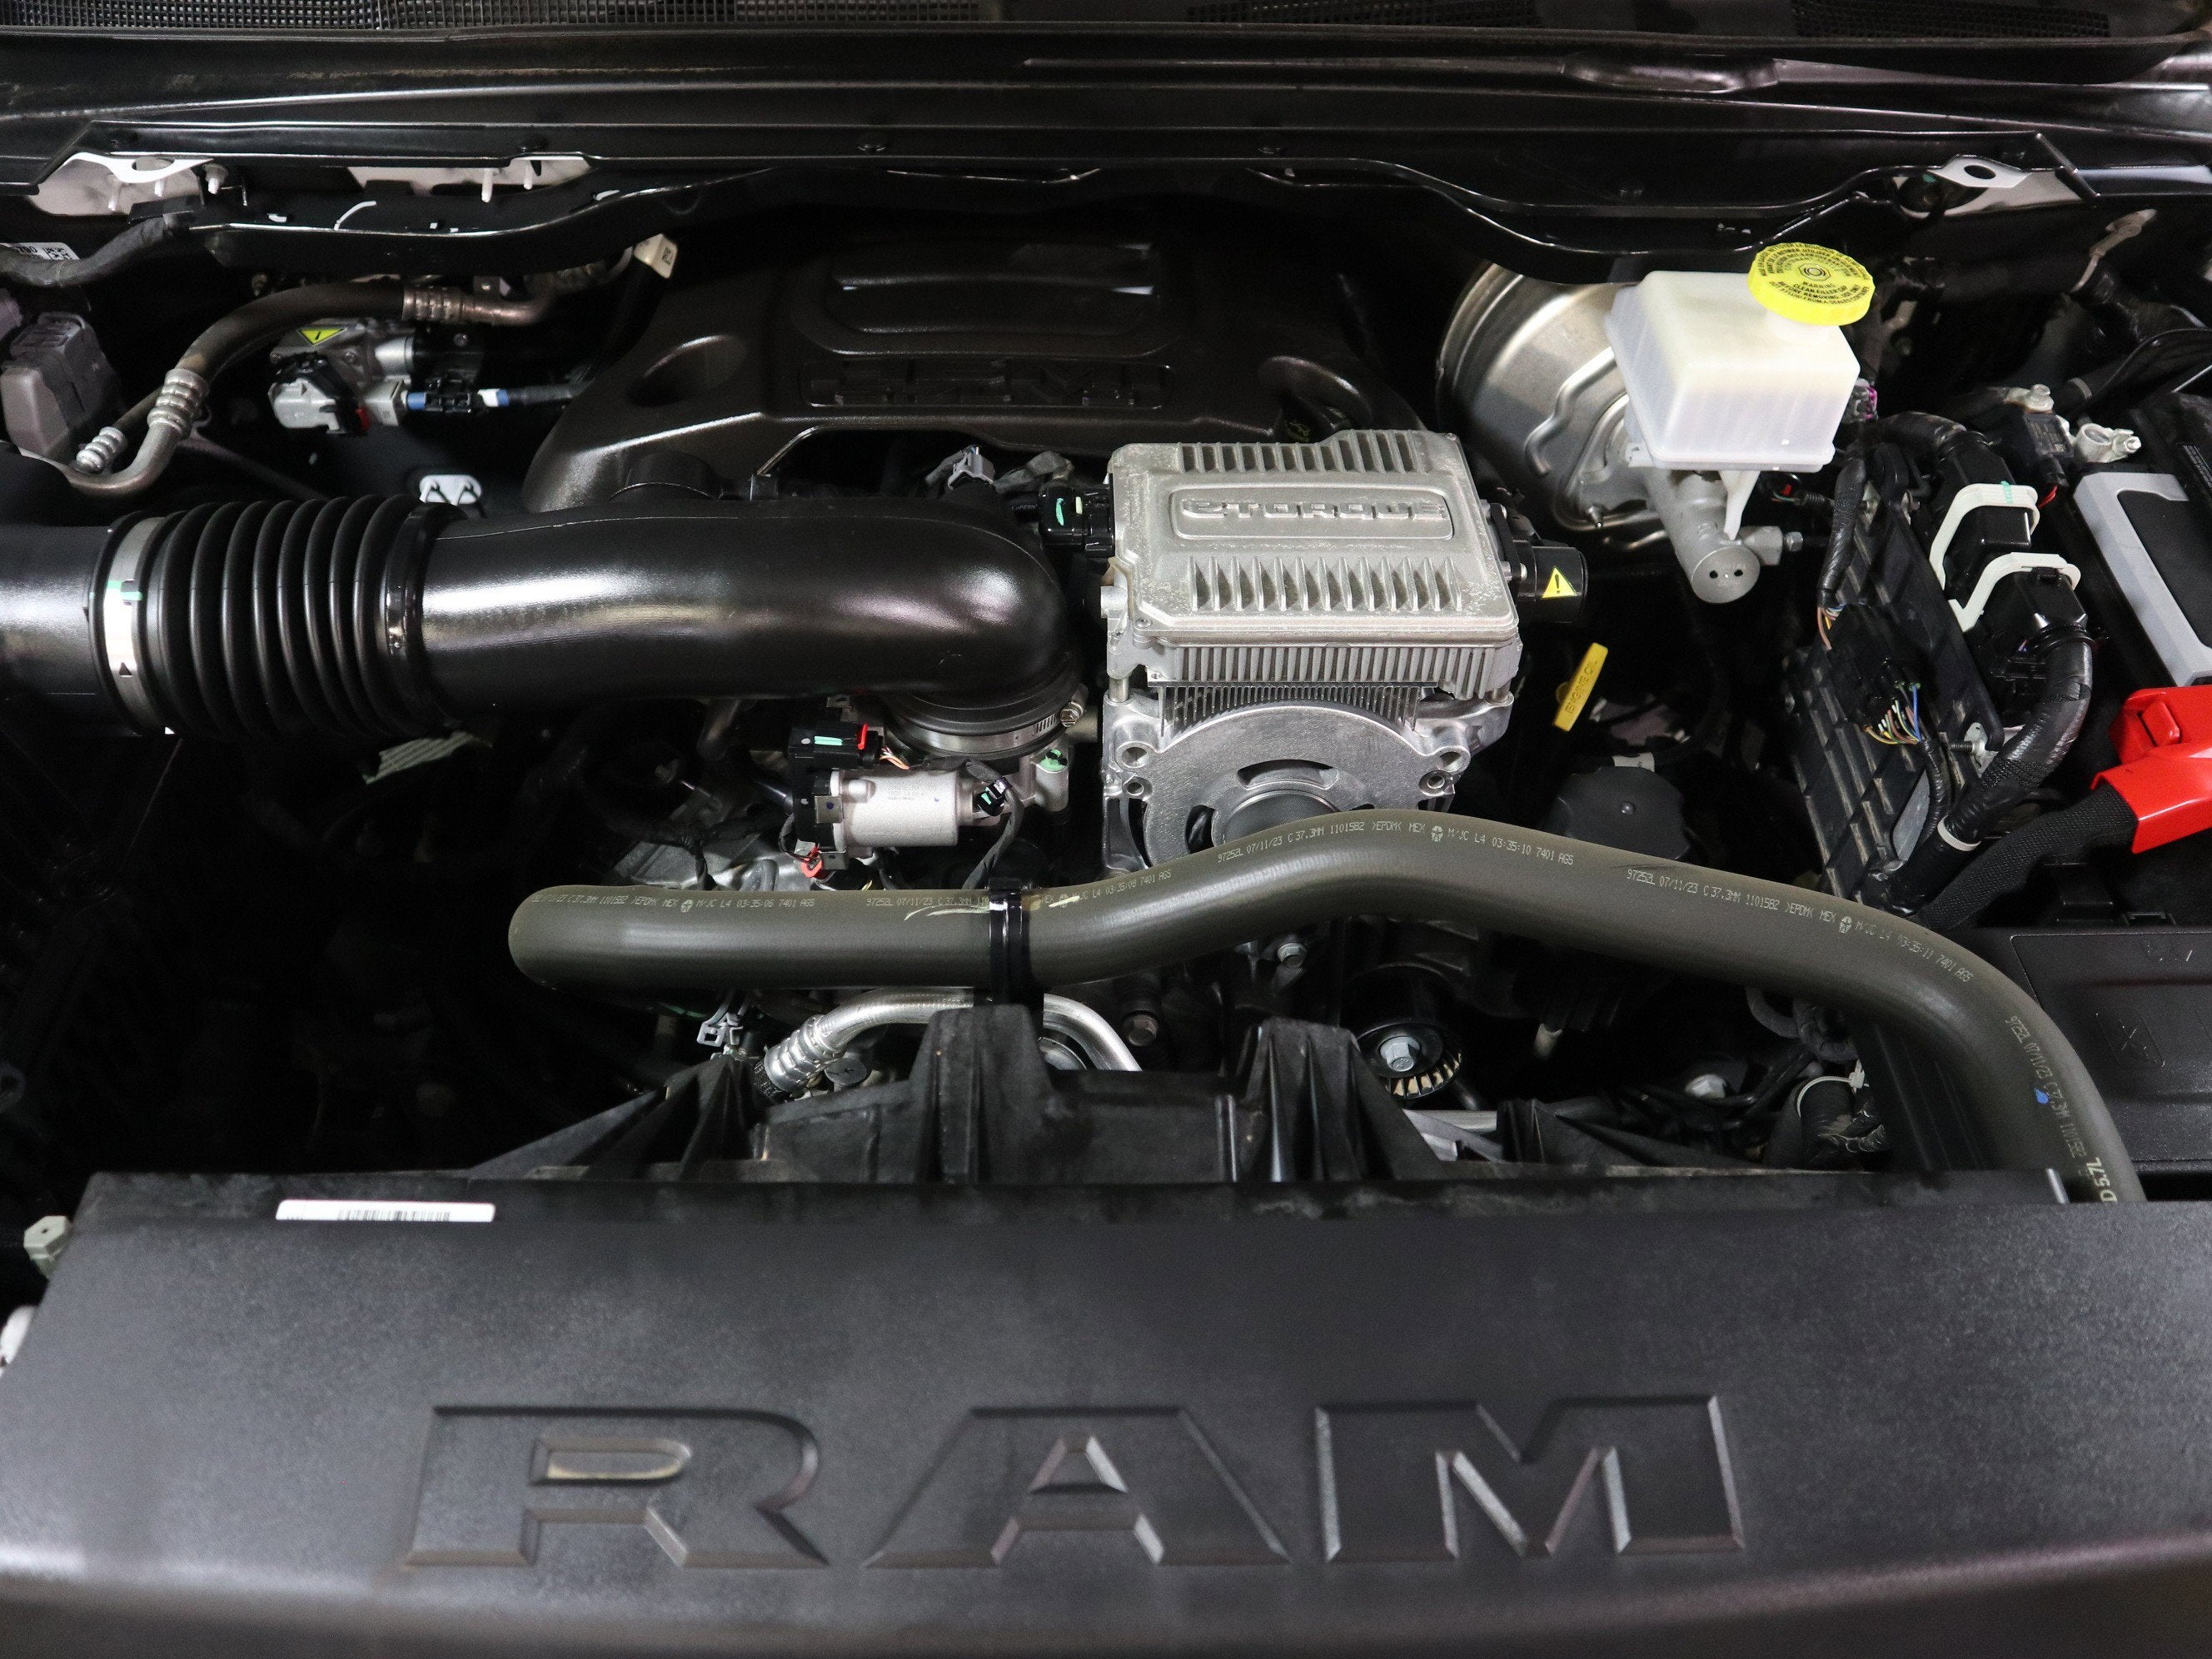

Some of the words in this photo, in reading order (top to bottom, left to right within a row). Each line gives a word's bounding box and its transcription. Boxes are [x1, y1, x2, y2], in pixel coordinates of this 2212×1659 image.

[1218, 849, 1243, 863] 97252L
[1246, 835, 1283, 854] 07/11/23
[1330, 821, 1365, 834] 1101582
[1408, 823, 1426, 834] MEX
[1492, 837, 1532, 855] 03:35:10
[1536, 847, 1554, 861] 7401
[1557, 852, 1574, 865] AGS
[1139, 877, 1156, 887] 7401
[1158, 869, 1172, 881] AGS
[662, 899, 679, 908] MEX
[720, 899, 732, 908] L4
[736, 899, 775, 908] 03:35:06
[778, 899, 797, 908] 7401
[866, 897, 894, 907] 97252L
[896, 897, 934, 906] 07/11/23
[1627, 869, 1656, 886] 97252L
[1659, 875, 1698, 894] 07/11/23
[1745, 894, 1781, 911] 1101582
[1819, 909, 1837, 924] MEX
[1935, 954, 1957, 972] 7401
[1954, 967, 1974, 983] AGS
[2085, 1157, 2110, 1187] 5.7L
[403, 1393, 1747, 1571] RAM
